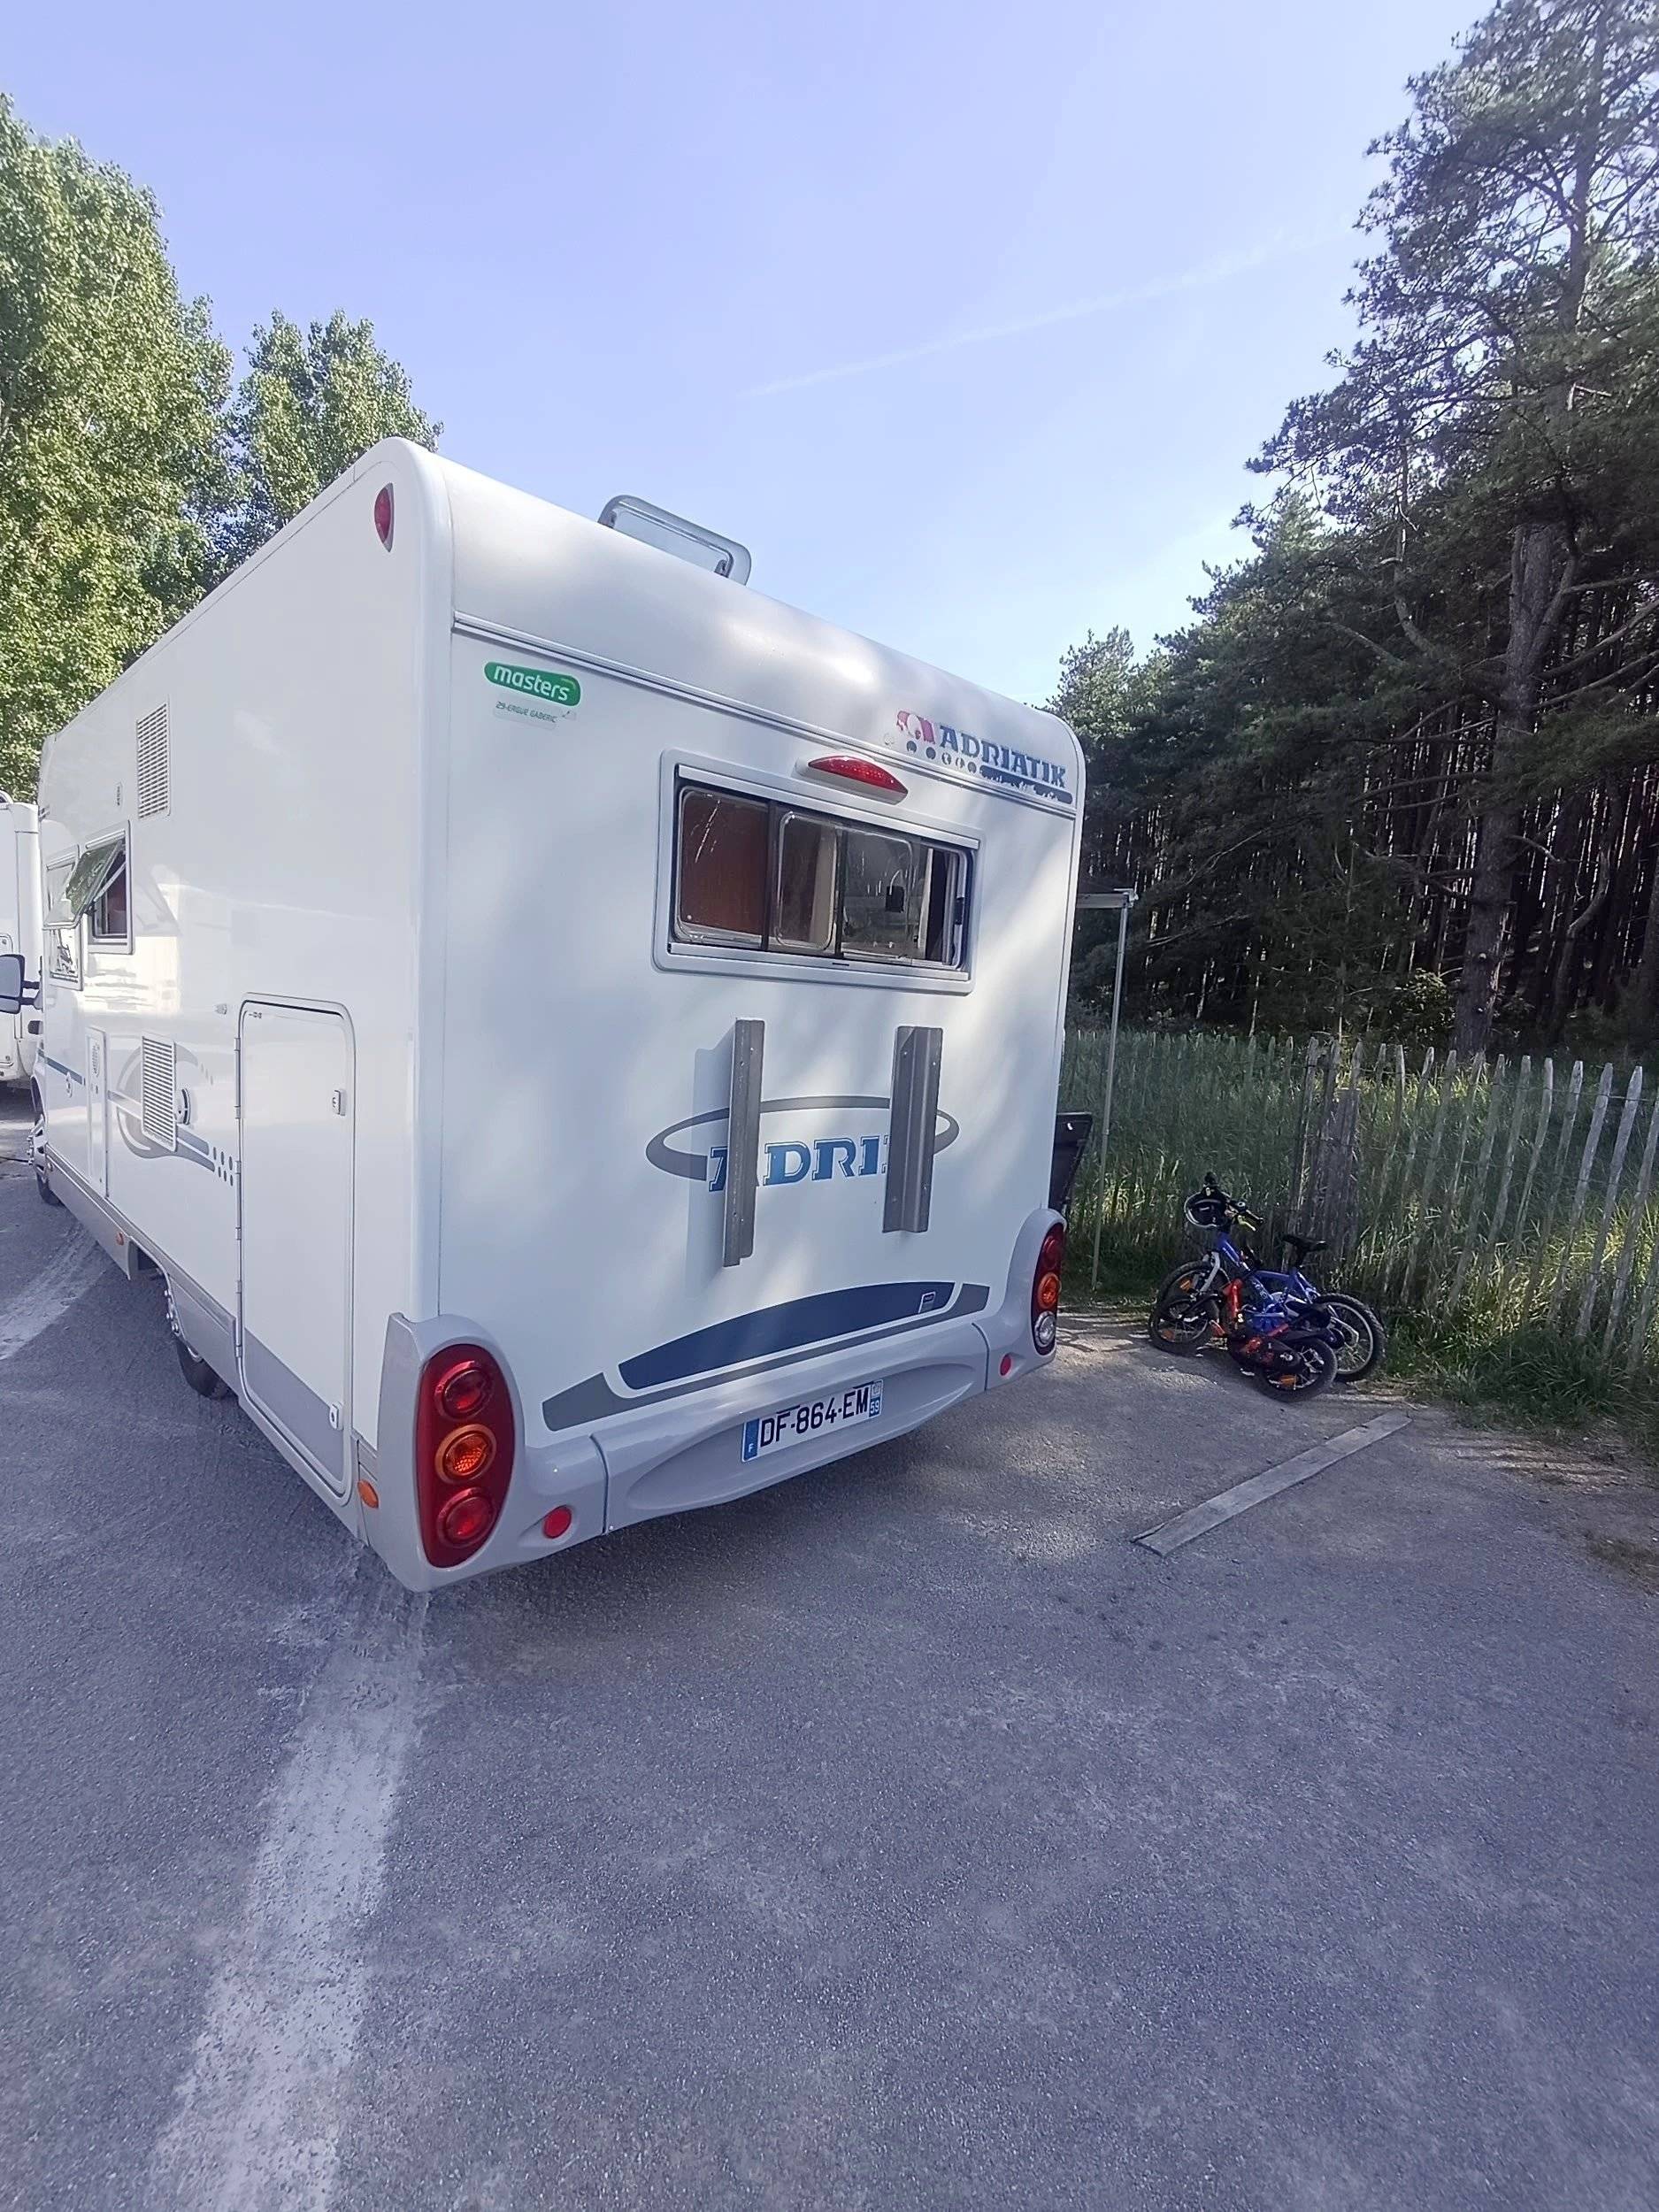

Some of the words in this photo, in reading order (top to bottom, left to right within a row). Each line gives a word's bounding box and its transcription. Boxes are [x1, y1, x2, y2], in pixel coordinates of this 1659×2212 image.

[494, 665, 570, 701] masters
[940, 724, 1067, 788] ADRIATIK
[760, 1386, 869, 1448] DF-864-EM
[870, 1400, 879, 1415] 59
[749, 1444, 754, 1453] F
